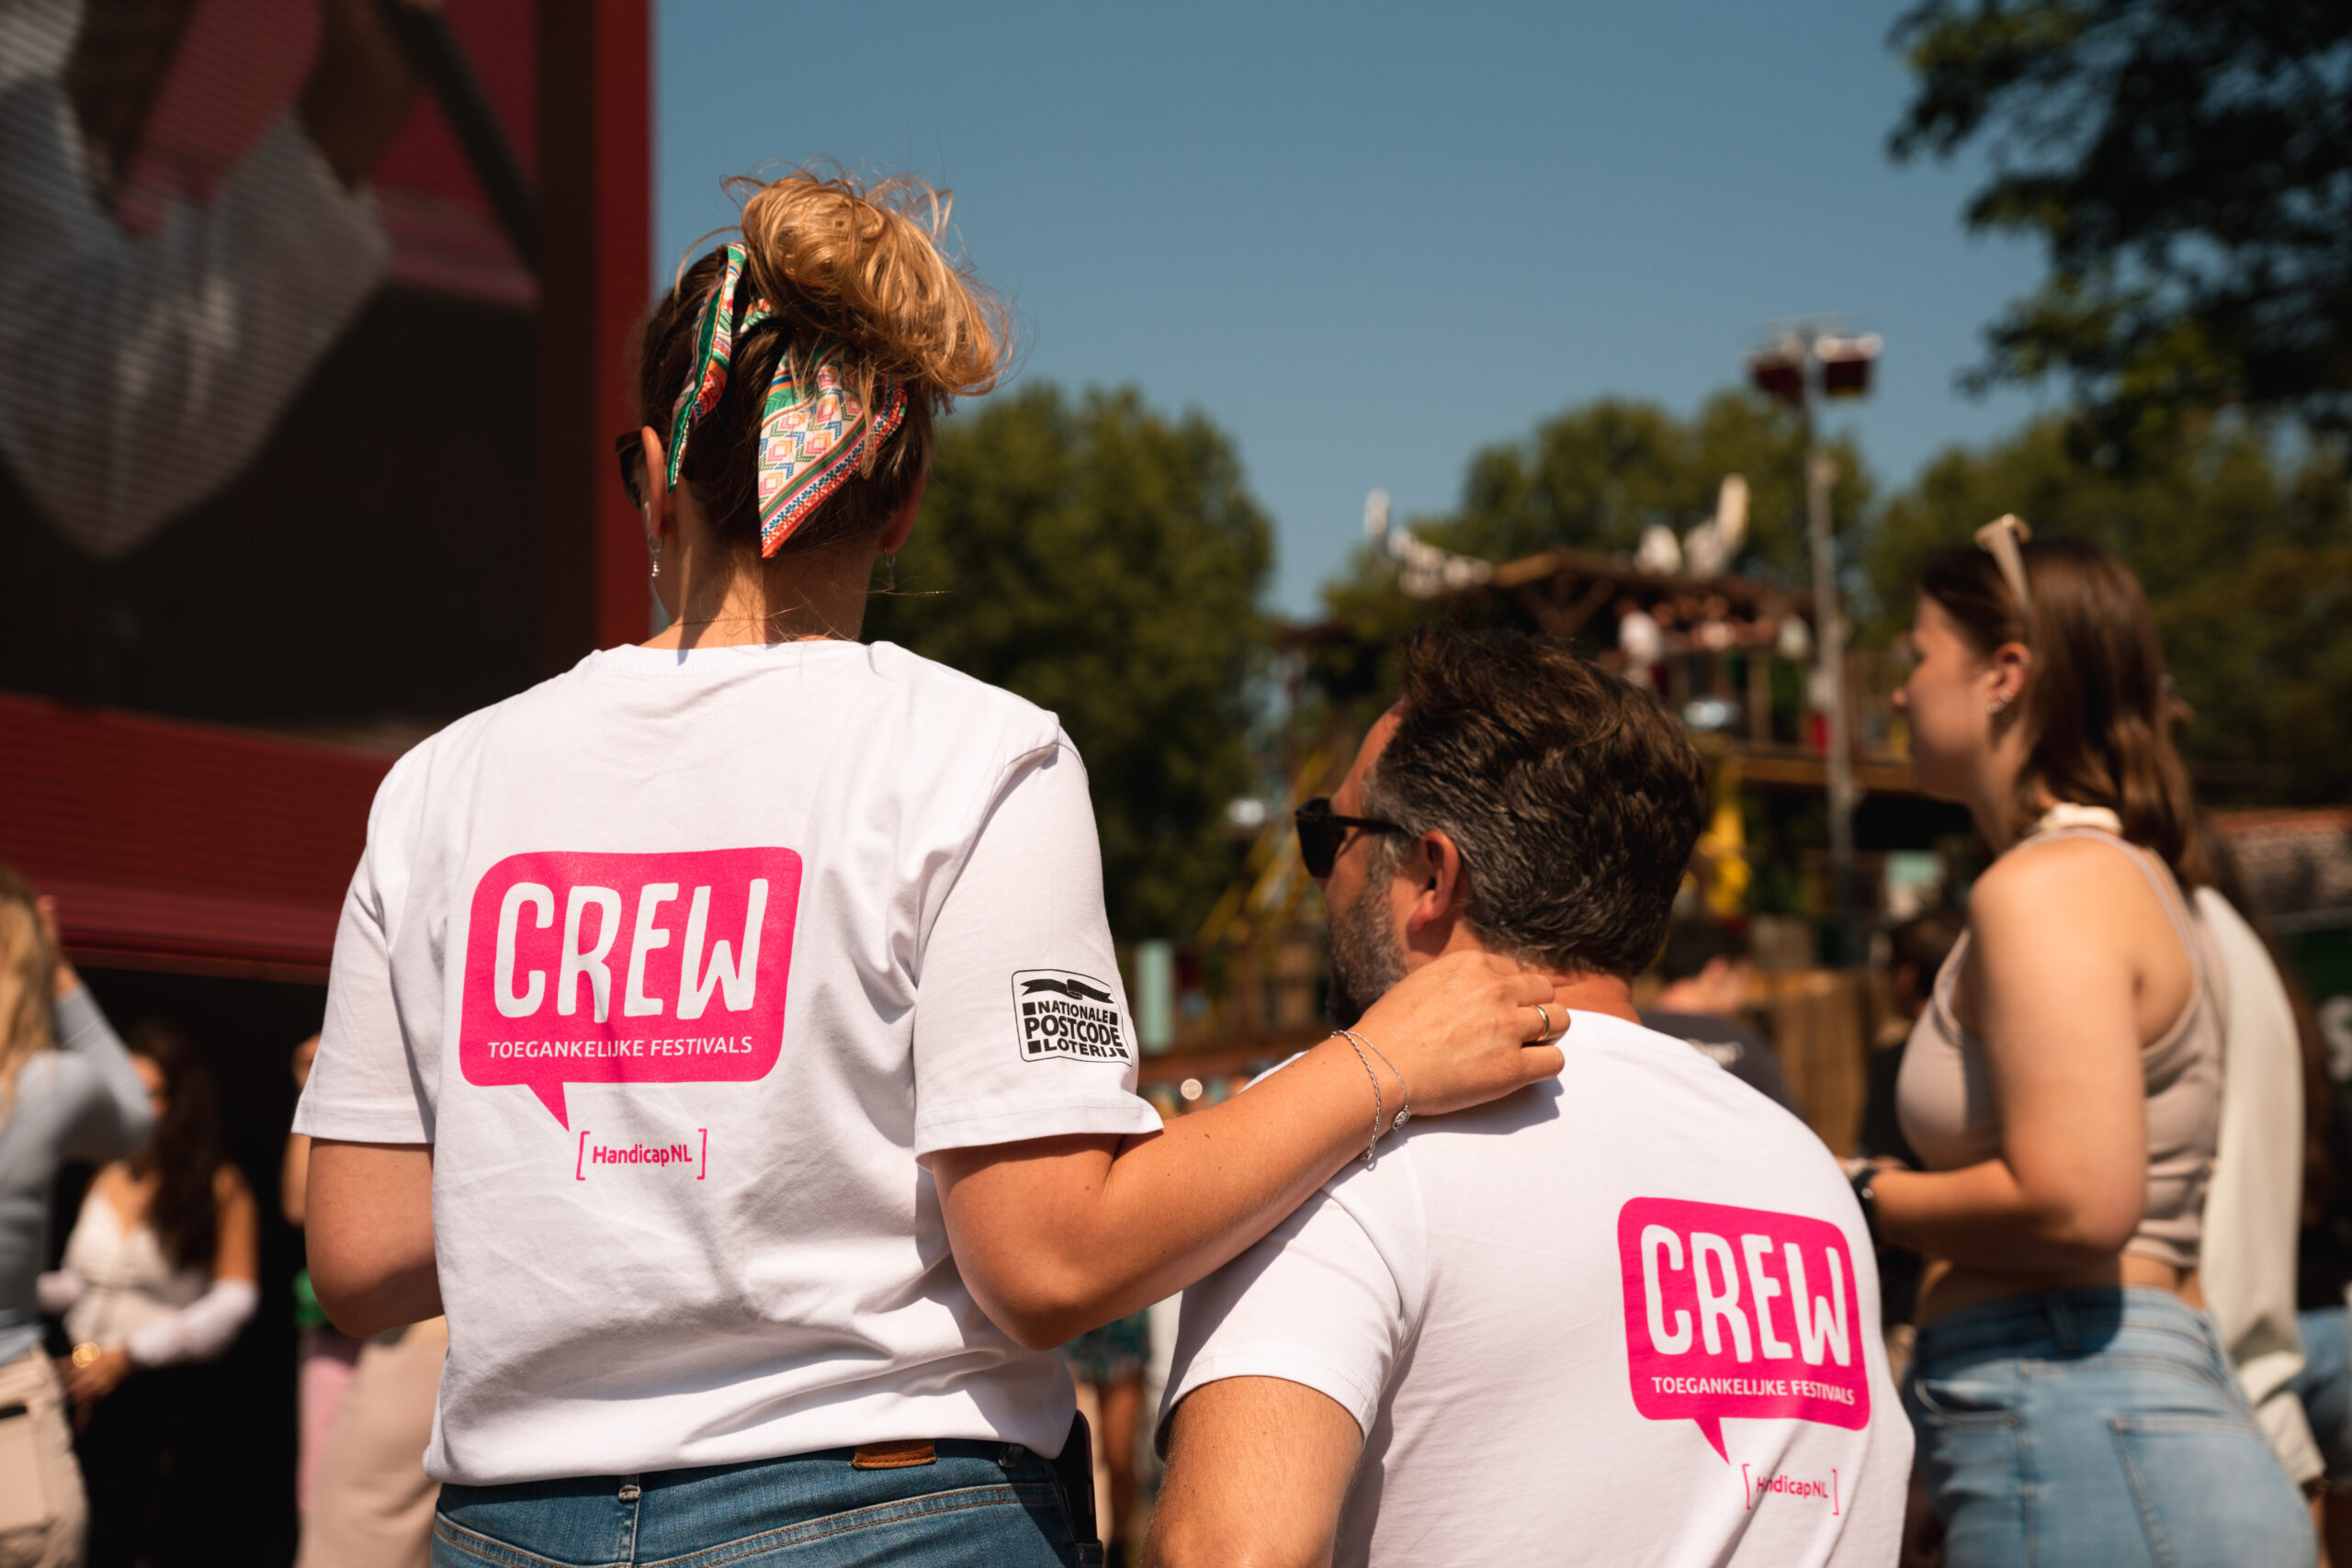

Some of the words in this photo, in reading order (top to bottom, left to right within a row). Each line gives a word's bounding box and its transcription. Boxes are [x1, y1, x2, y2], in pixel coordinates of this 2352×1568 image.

[494, 878, 769, 1023] CREW
[1037, 1000, 1108, 1023] NATIONALE
[1024, 1015, 1123, 1047] POSTCODE
[488, 1039, 644, 1058] TOEGANKELIJKE
[650, 1036, 752, 1055] FESTIVALS
[1044, 1038, 1117, 1057] LOTERIJ
[1641, 1224, 1850, 1367] CREW
[1651, 1377, 1788, 1396] TOEGANKELIJKE
[1792, 1380, 1855, 1405] FESTIVALS
[1757, 1474, 1828, 1499] HndicapNL
